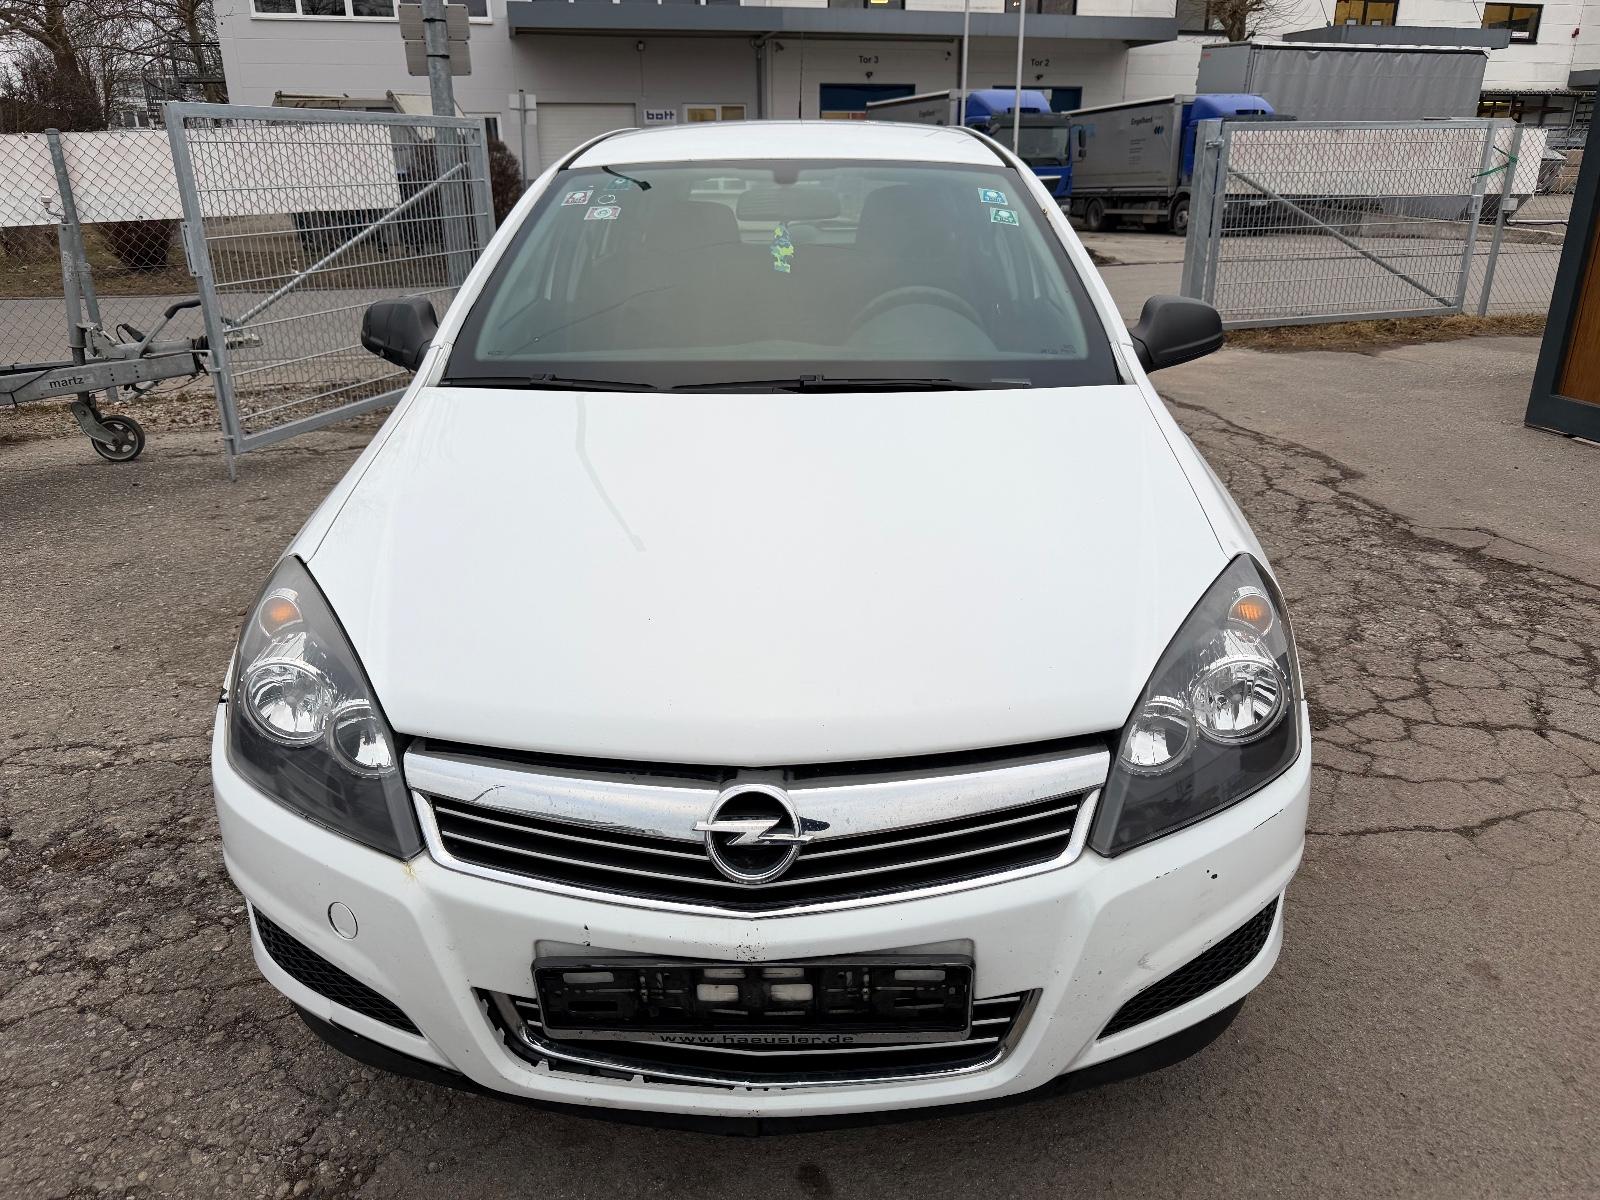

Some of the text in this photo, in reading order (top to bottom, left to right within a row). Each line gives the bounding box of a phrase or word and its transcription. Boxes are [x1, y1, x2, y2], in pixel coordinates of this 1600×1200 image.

[858, 55, 880, 64] Tor 3
[1030, 58, 1050, 67] Tor 2
[646, 110, 675, 120] bott
[49, 376, 85, 389] martz
